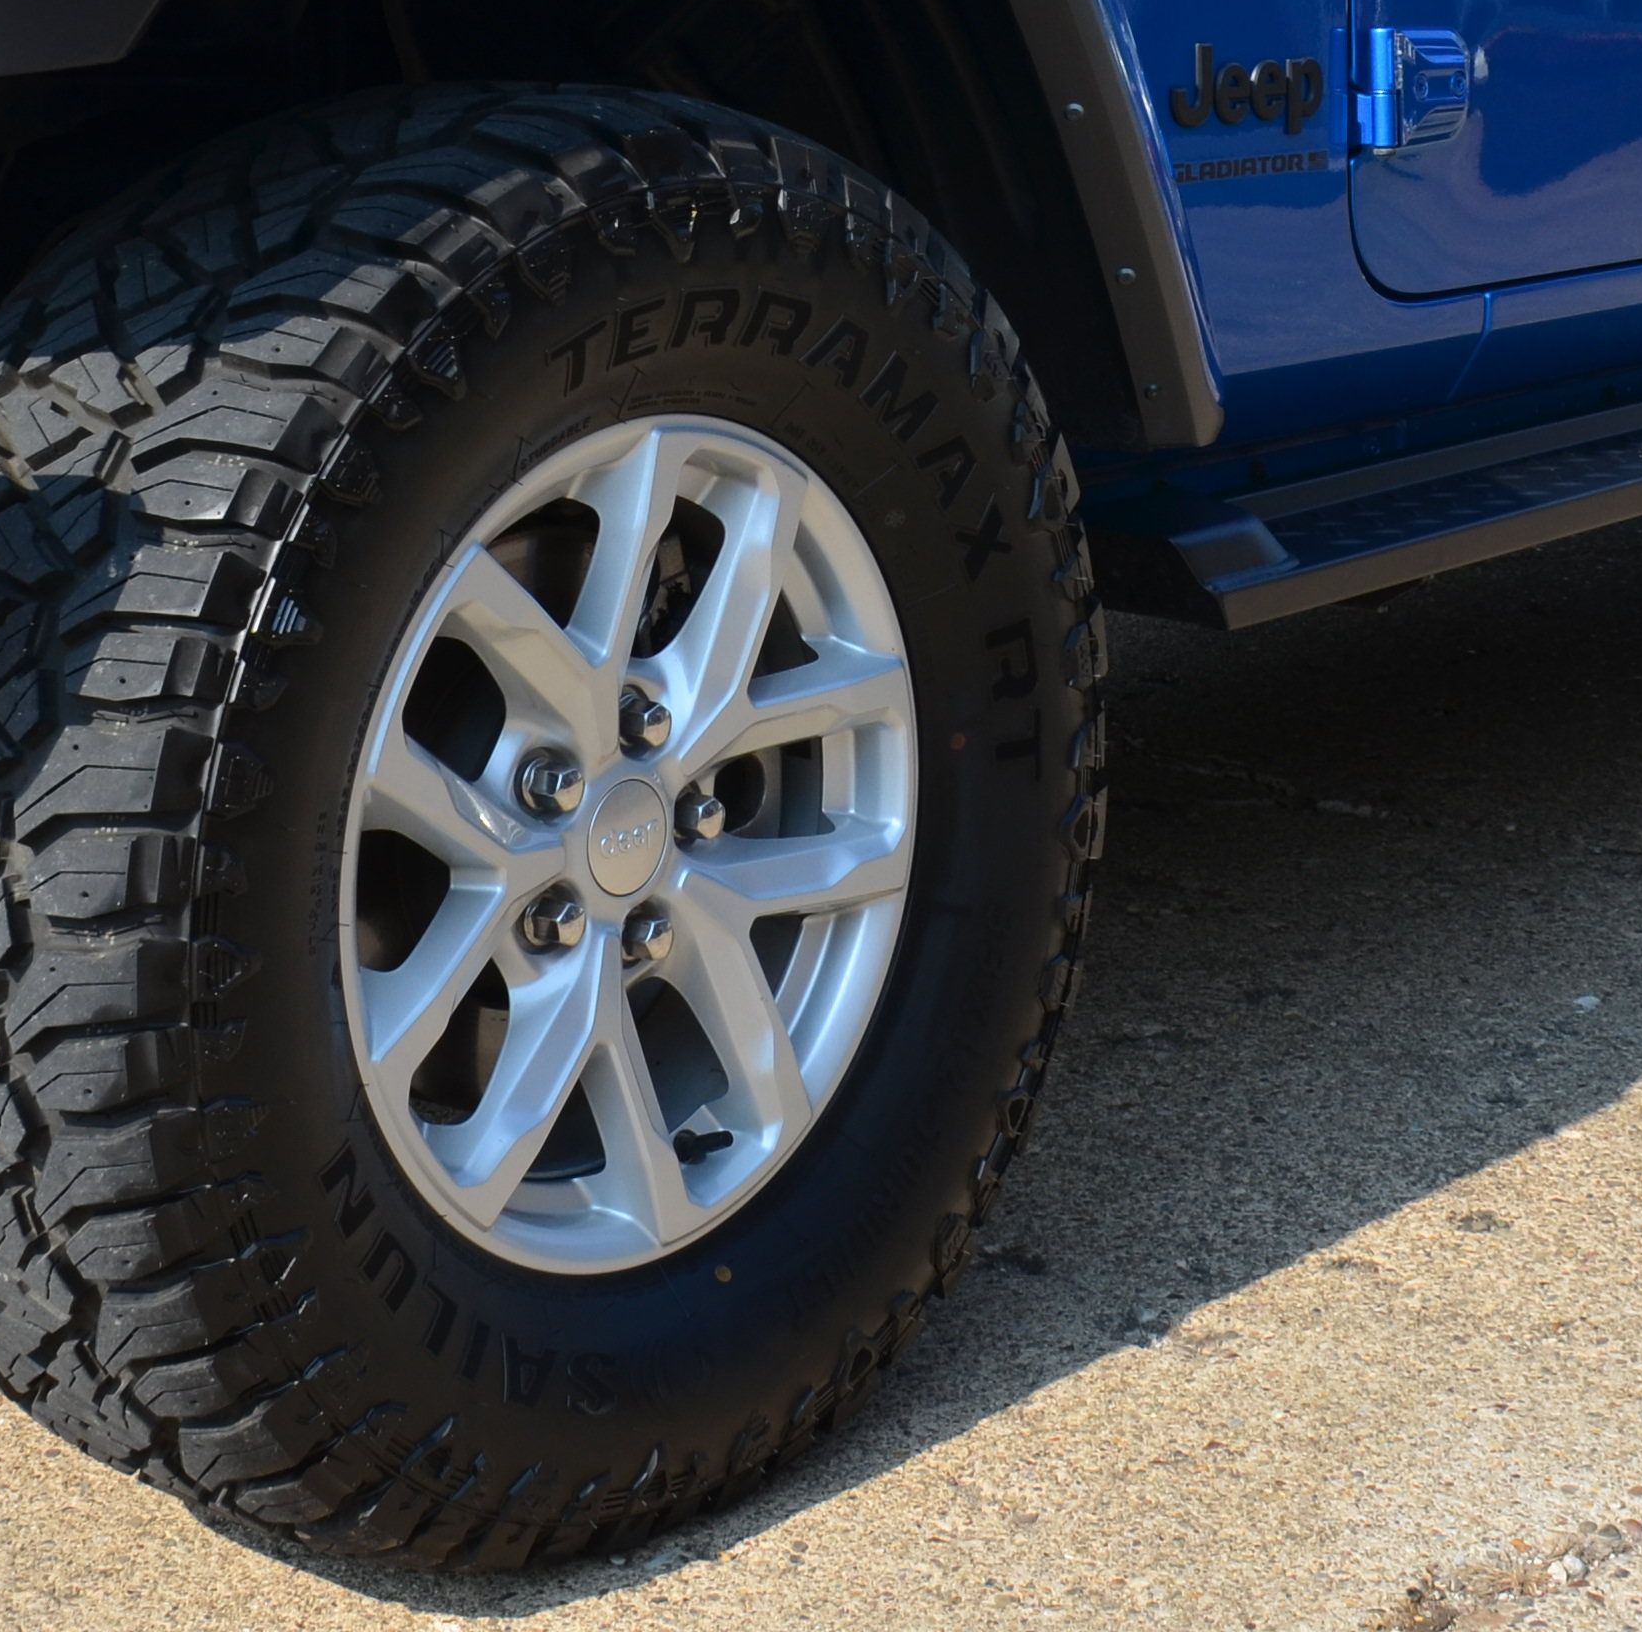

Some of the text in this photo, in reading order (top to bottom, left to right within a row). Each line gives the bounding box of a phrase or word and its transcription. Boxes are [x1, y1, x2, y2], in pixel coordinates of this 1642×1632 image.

[1170, 42, 1325, 136] Jeep
[1172, 153, 1304, 184] GLADIATOR
[544, 286, 1013, 583] TERRAMAX
[984, 617, 1043, 782] RT
[317, 1141, 619, 1417] SAILUN
